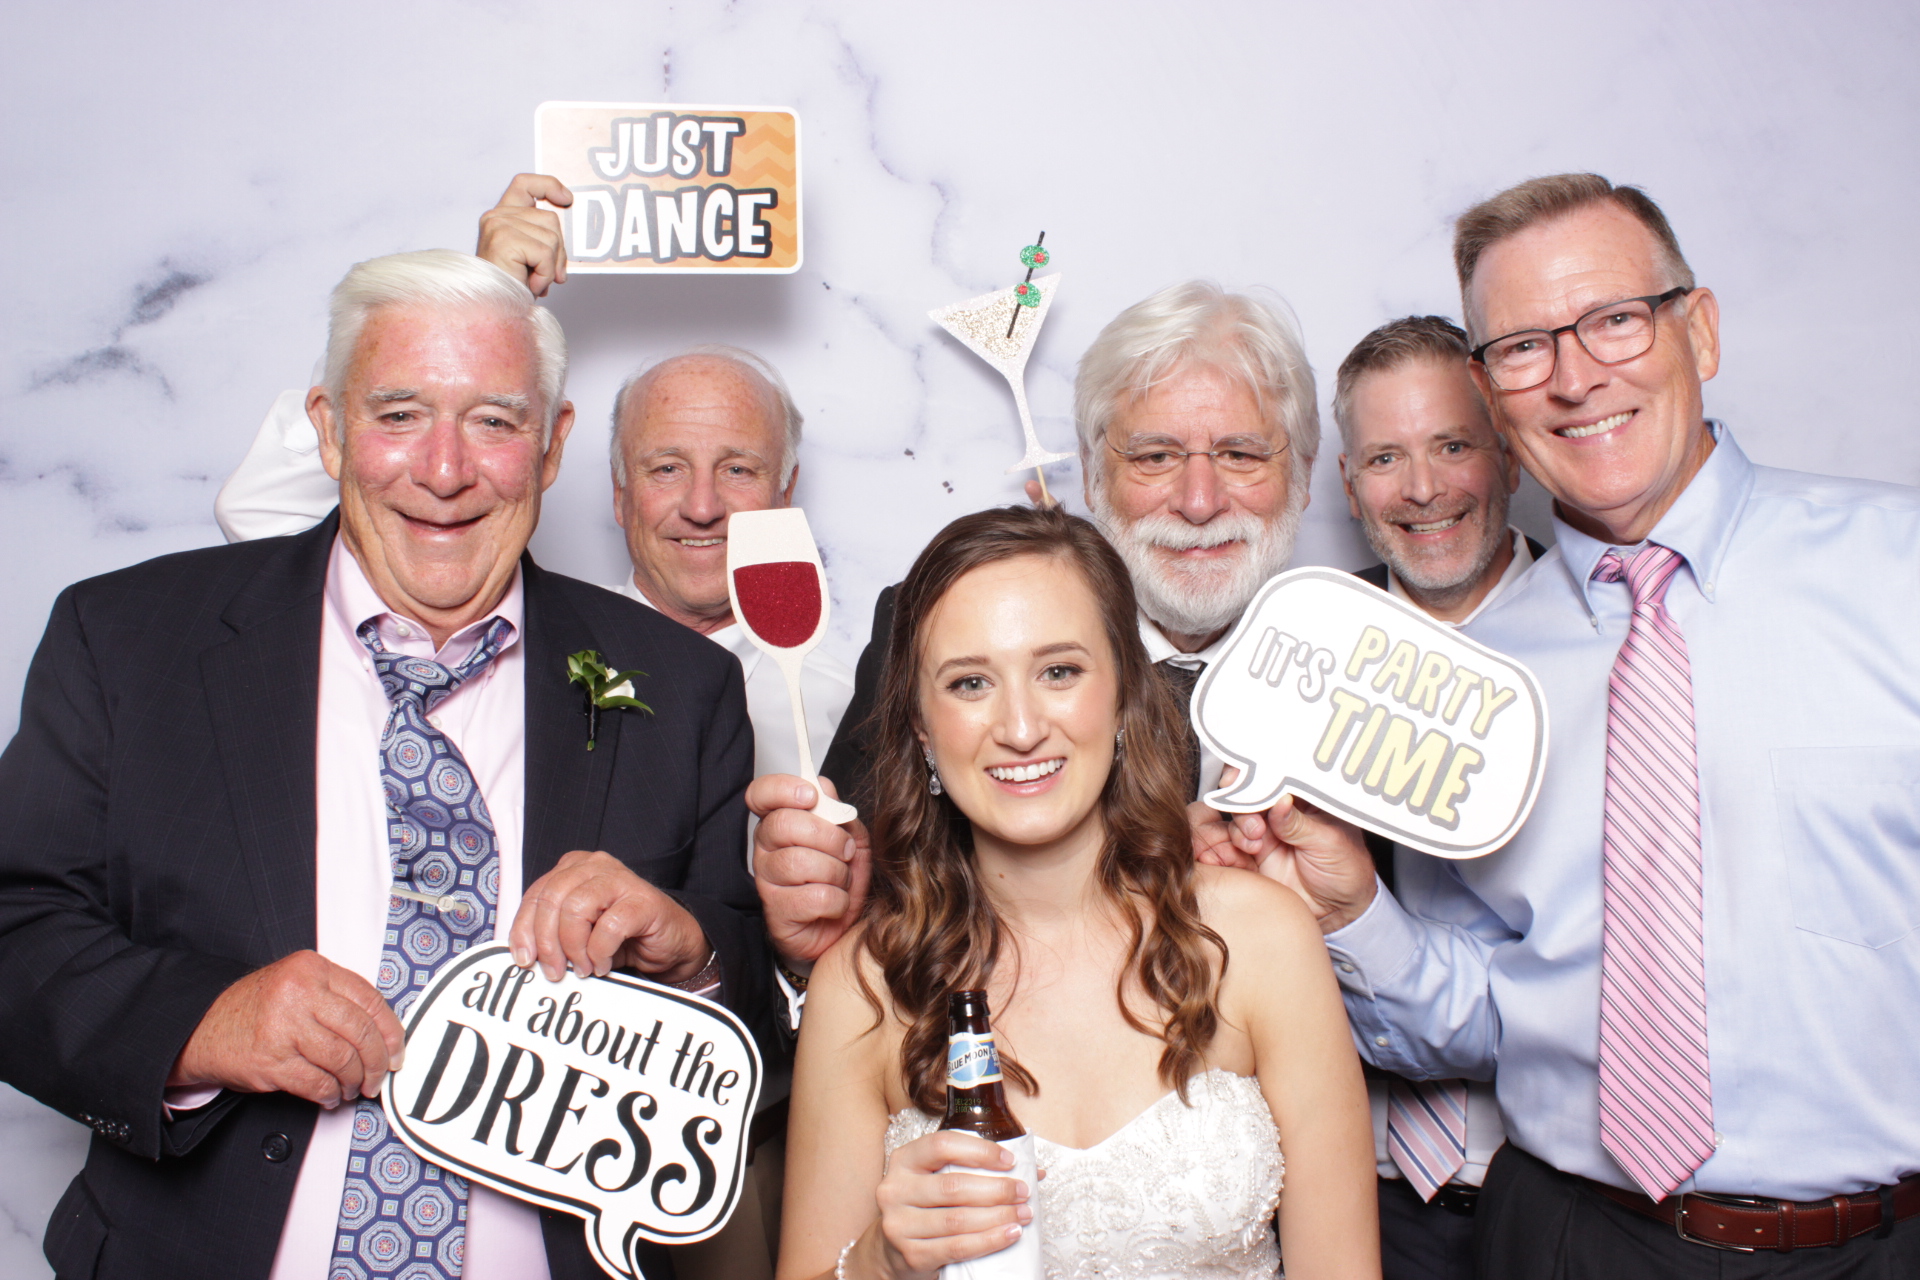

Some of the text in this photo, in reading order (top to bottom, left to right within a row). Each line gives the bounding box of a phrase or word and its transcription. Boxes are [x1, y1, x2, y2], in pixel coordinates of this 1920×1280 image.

[588, 112, 746, 180] JUST
[565, 183, 778, 263] DANCE
[1248, 625, 1517, 740] IT'S PARTY
[1313, 687, 1485, 831] TIME
[462, 964, 740, 1106] all about the
[964, 1047, 989, 1064] MOON
[406, 1019, 723, 1217] DRESS
